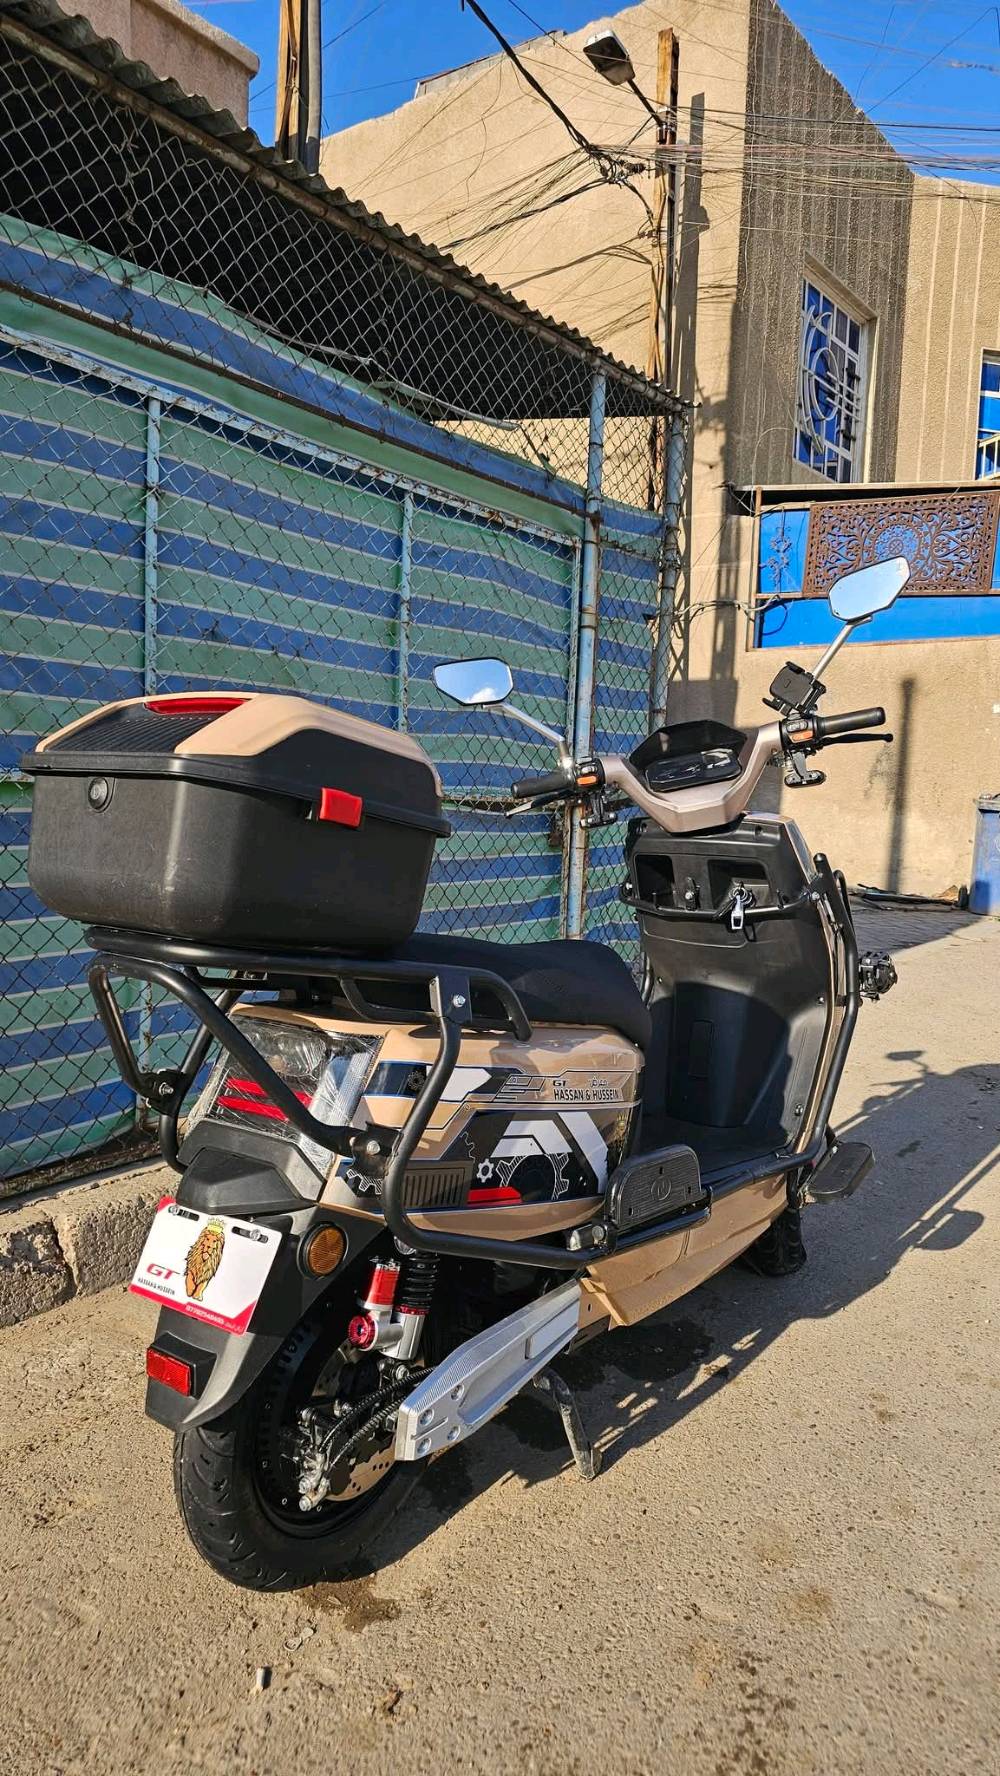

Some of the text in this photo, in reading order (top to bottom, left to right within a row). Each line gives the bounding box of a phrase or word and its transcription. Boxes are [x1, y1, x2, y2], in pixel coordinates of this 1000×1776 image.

[553, 1088, 620, 1101] HASSAN & HUSSEIN
[146, 1263, 180, 1280] GT
